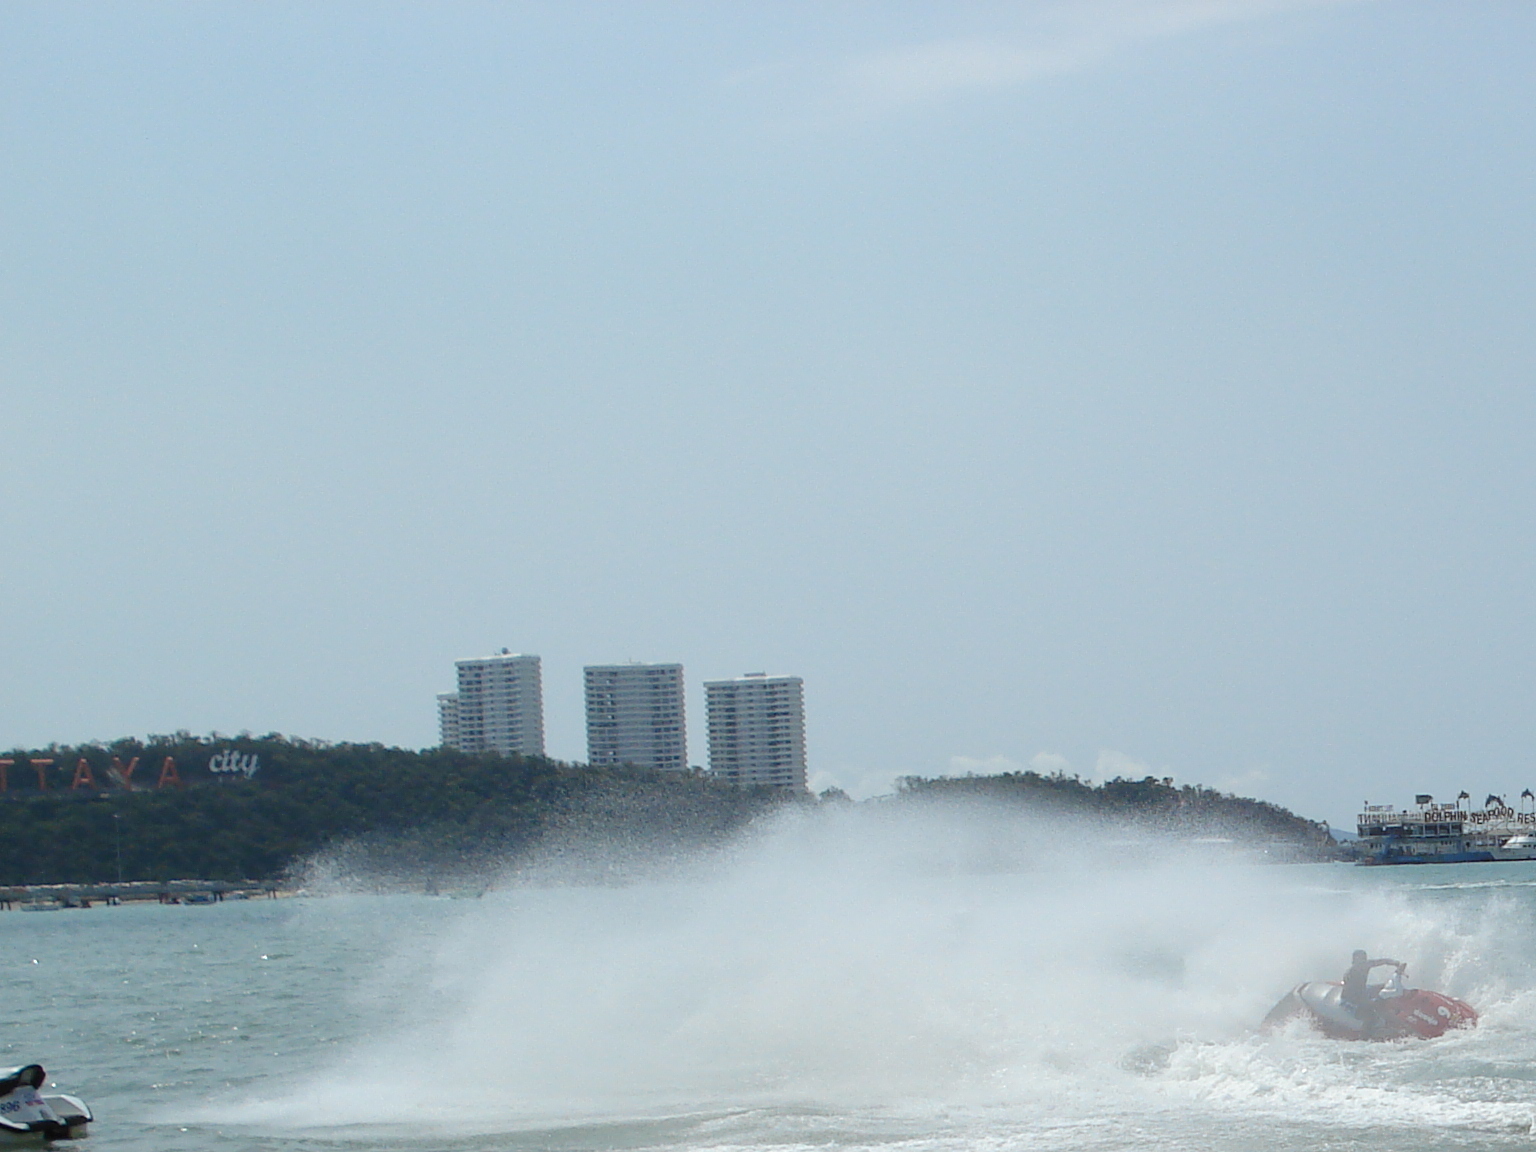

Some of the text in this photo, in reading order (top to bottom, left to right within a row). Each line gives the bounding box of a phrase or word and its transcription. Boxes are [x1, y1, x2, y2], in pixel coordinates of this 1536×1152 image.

[208, 748, 261, 780] city
[1424, 810, 1469, 823] DOLPHIN
[1470, 806, 1515, 825] SEAFOOD
